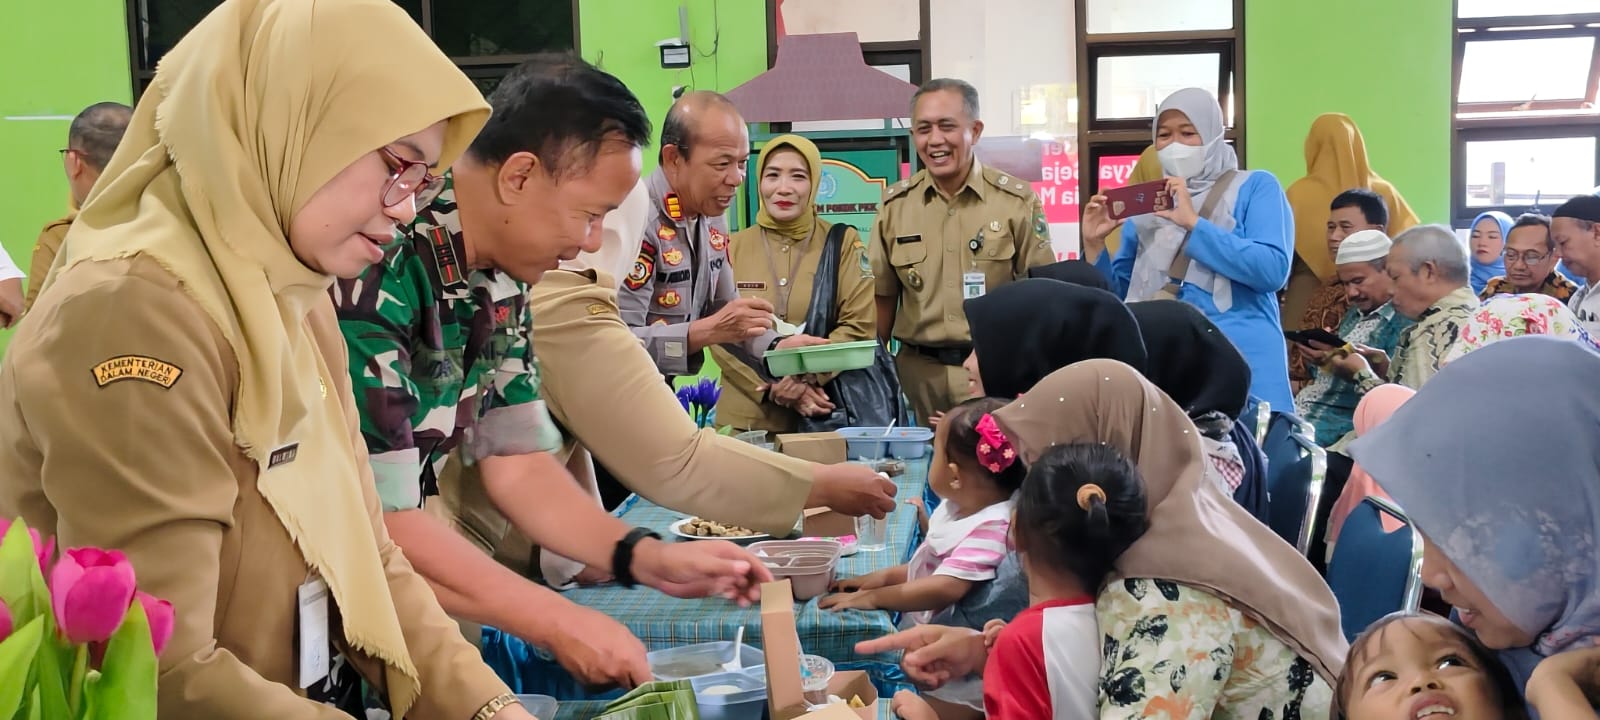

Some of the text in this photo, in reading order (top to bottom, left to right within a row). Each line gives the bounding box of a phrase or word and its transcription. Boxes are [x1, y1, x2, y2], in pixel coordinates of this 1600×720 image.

[101, 358, 173, 375] KEMENTERIAN
[100, 368, 171, 385] DALAM NEGERI
